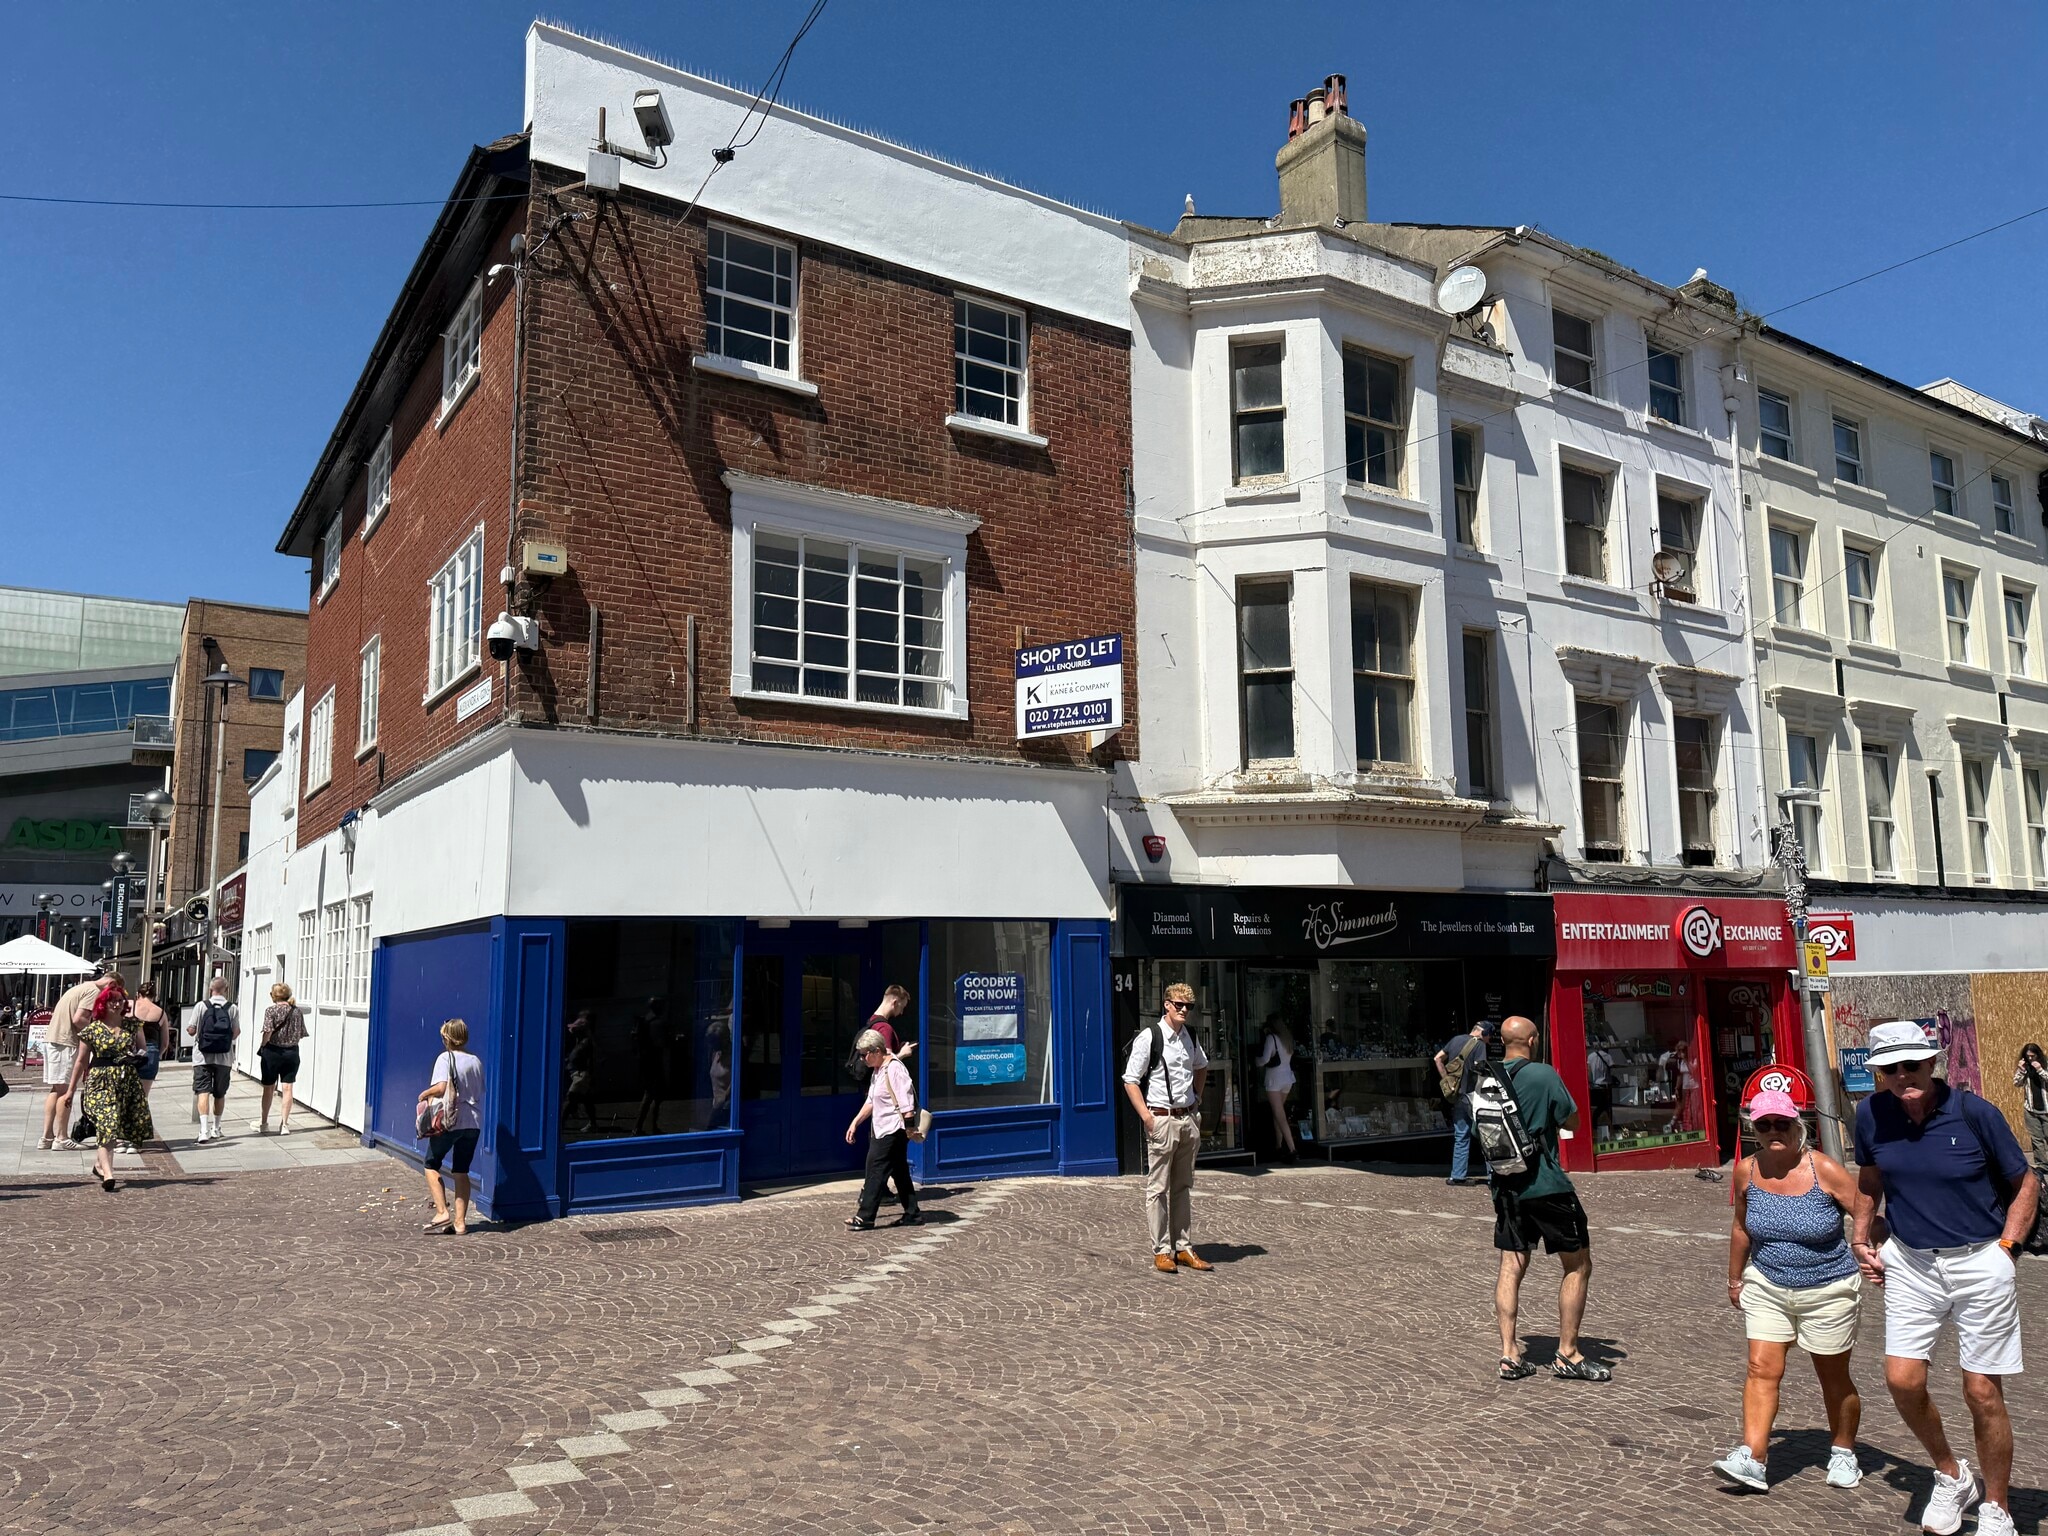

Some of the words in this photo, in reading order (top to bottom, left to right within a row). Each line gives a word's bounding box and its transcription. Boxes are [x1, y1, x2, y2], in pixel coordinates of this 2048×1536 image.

[1020, 647, 1061, 667] SHOP
[1064, 643, 1086, 660] TO
[1090, 638, 1116, 657] LET
[1044, 664, 1056, 673] ALL
[1057, 659, 1091, 671] ENQUIRIES
[1049, 686, 1068, 696] KANE
[1069, 686, 1074, 694] &
[1074, 681, 1111, 693] COMPANY
[1029, 710, 1049, 723] 020
[1052, 706, 1079, 720] 7224
[1083, 702, 1107, 716] 0101
[1031, 715, 1105, 731] www.stephenkane.co.uk
[8, 818, 123, 850] ASDA
[115, 883, 125, 928] DEICHMANN
[1153, 912, 1190, 923] Diamond
[1233, 912, 1262, 925] Repairs
[1263, 913, 1270, 923] &
[1316, 901, 1398, 949] Simmonds
[1151, 924, 1193, 935] Merchants
[1233, 924, 1272, 935] Valuations
[1421, 920, 1437, 932] The
[1439, 920, 1472, 934] Jewellers
[1474, 921, 1482, 932] of
[1483, 921, 1495, 932] the
[1497, 922, 1518, 933] South
[1519, 923, 1535, 933] East
[1562, 923, 1670, 941] ENTERTAINMENT
[1724, 925, 1783, 941] EXCHANGE
[964, 976, 1017, 988] GOODBYE
[1115, 973, 1133, 992] 34
[963, 989, 985, 1001] FOR
[987, 988, 1017, 1000] NOW!
[967, 1052, 1015, 1061] shoezone.com
[1843, 1052, 1869, 1066] MOTIS
